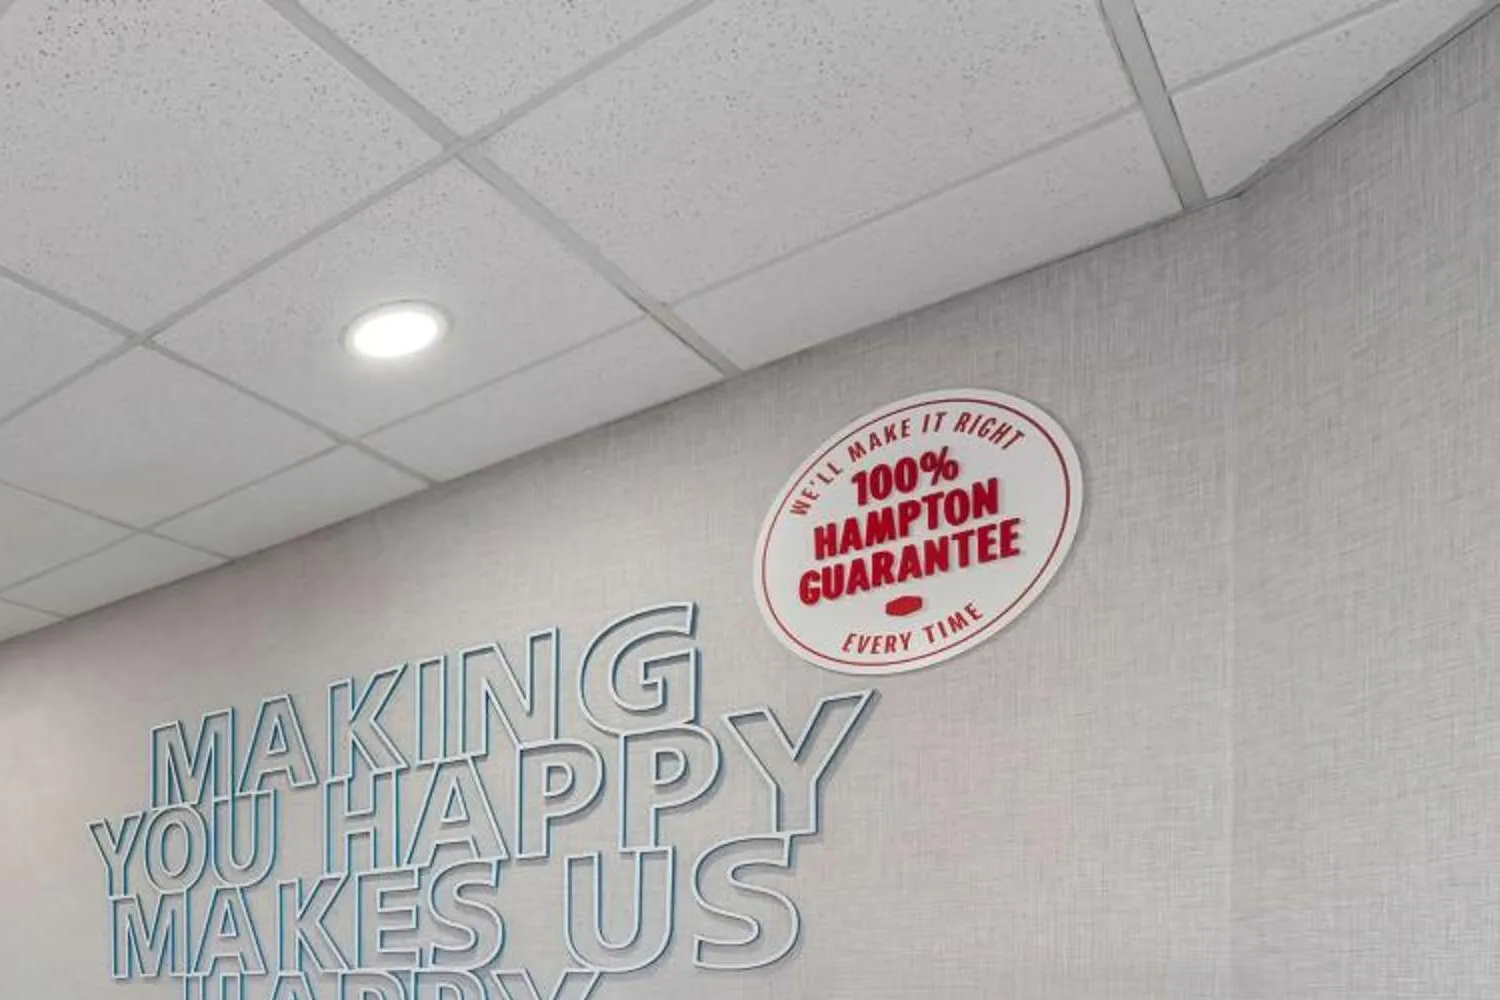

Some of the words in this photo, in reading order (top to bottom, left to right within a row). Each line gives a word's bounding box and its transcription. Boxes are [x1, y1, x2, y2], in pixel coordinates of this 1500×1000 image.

[790, 463, 843, 516] WE'LL
[847, 419, 911, 463] MAKE
[920, 412, 949, 434] IT
[954, 412, 1025, 450] RIGHT
[851, 446, 959, 506] 100%
[798, 517, 1021, 606] GUARANTEE
[813, 478, 998, 560] HAMPTON
[841, 632, 912, 655] EVERY
[922, 602, 985, 644] TIME
[150, 601, 700, 806] MAKING
[88, 790, 279, 900] YOU
[324, 688, 880, 874] HAPPY
[109, 861, 506, 978] MAKES
[564, 833, 802, 974] US
